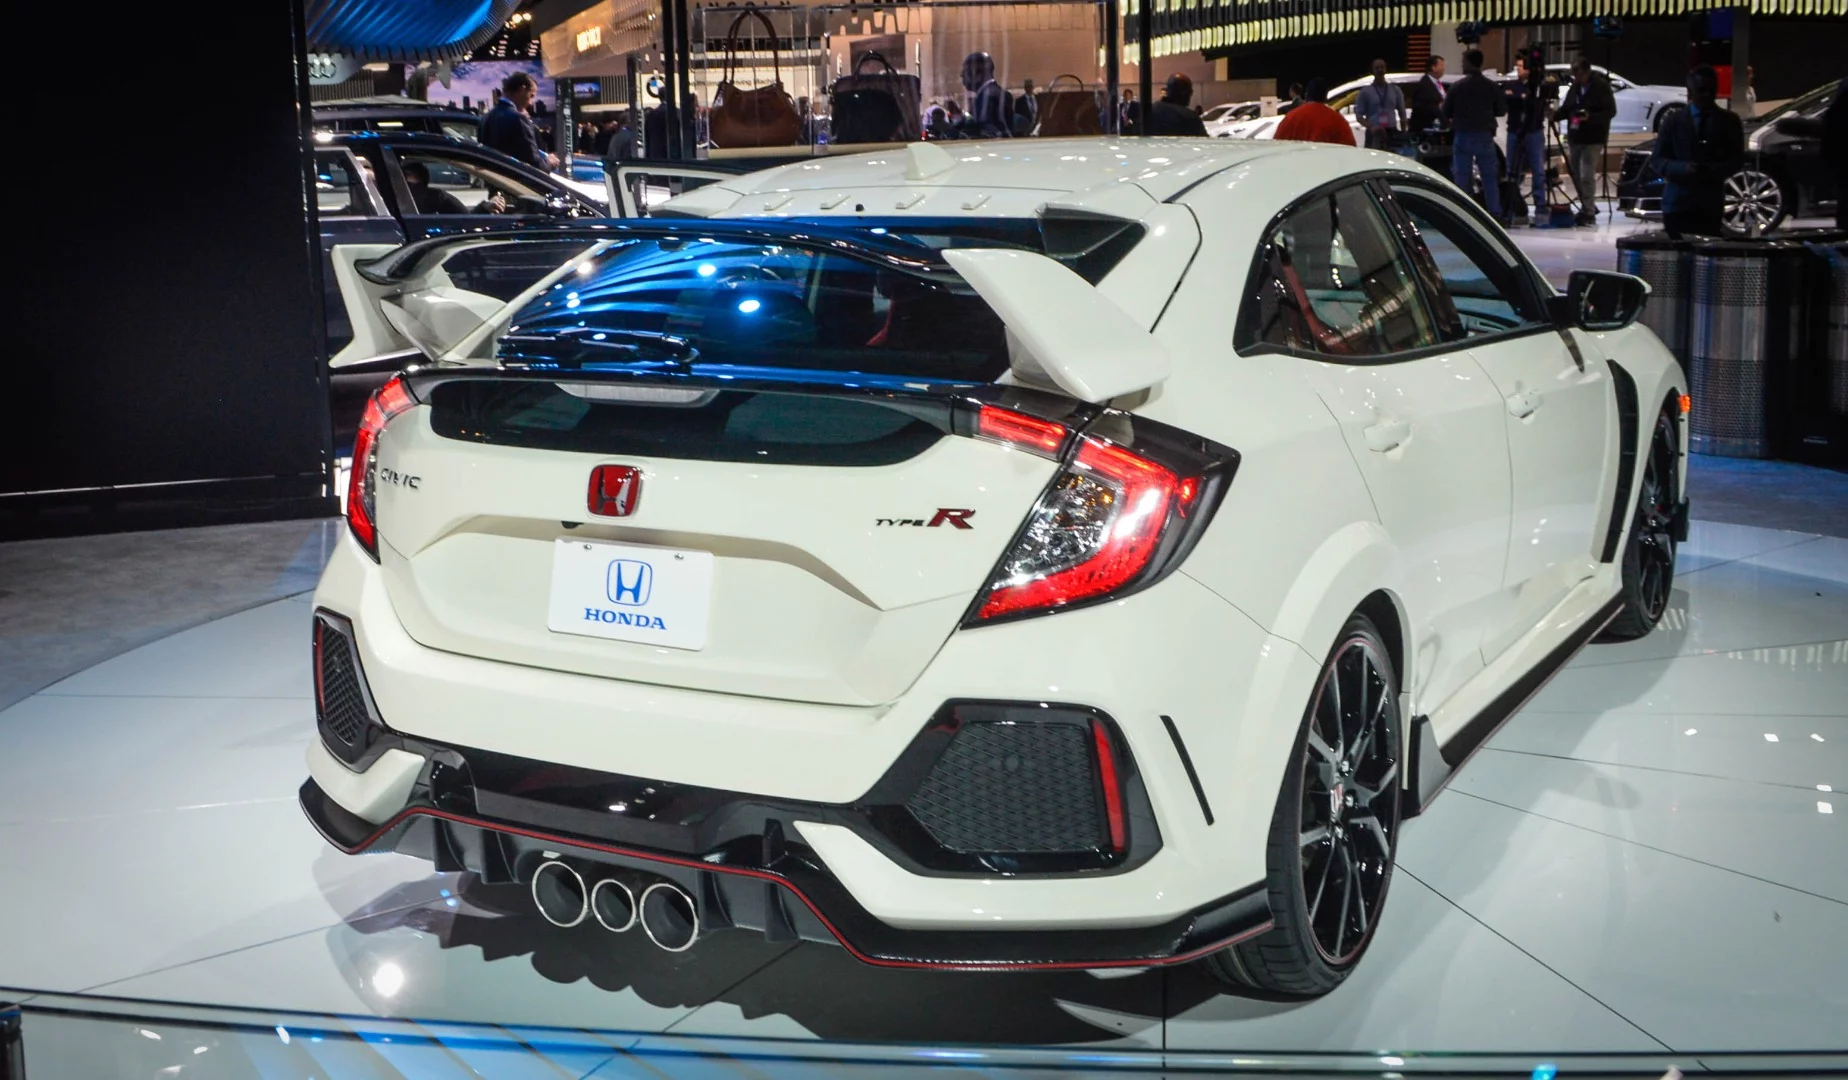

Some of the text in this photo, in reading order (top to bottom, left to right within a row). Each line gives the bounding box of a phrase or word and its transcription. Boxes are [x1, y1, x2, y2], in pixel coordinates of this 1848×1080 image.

[381, 468, 422, 489] CIVIC
[876, 507, 976, 530] TYPE R
[584, 607, 667, 631] HONDA
